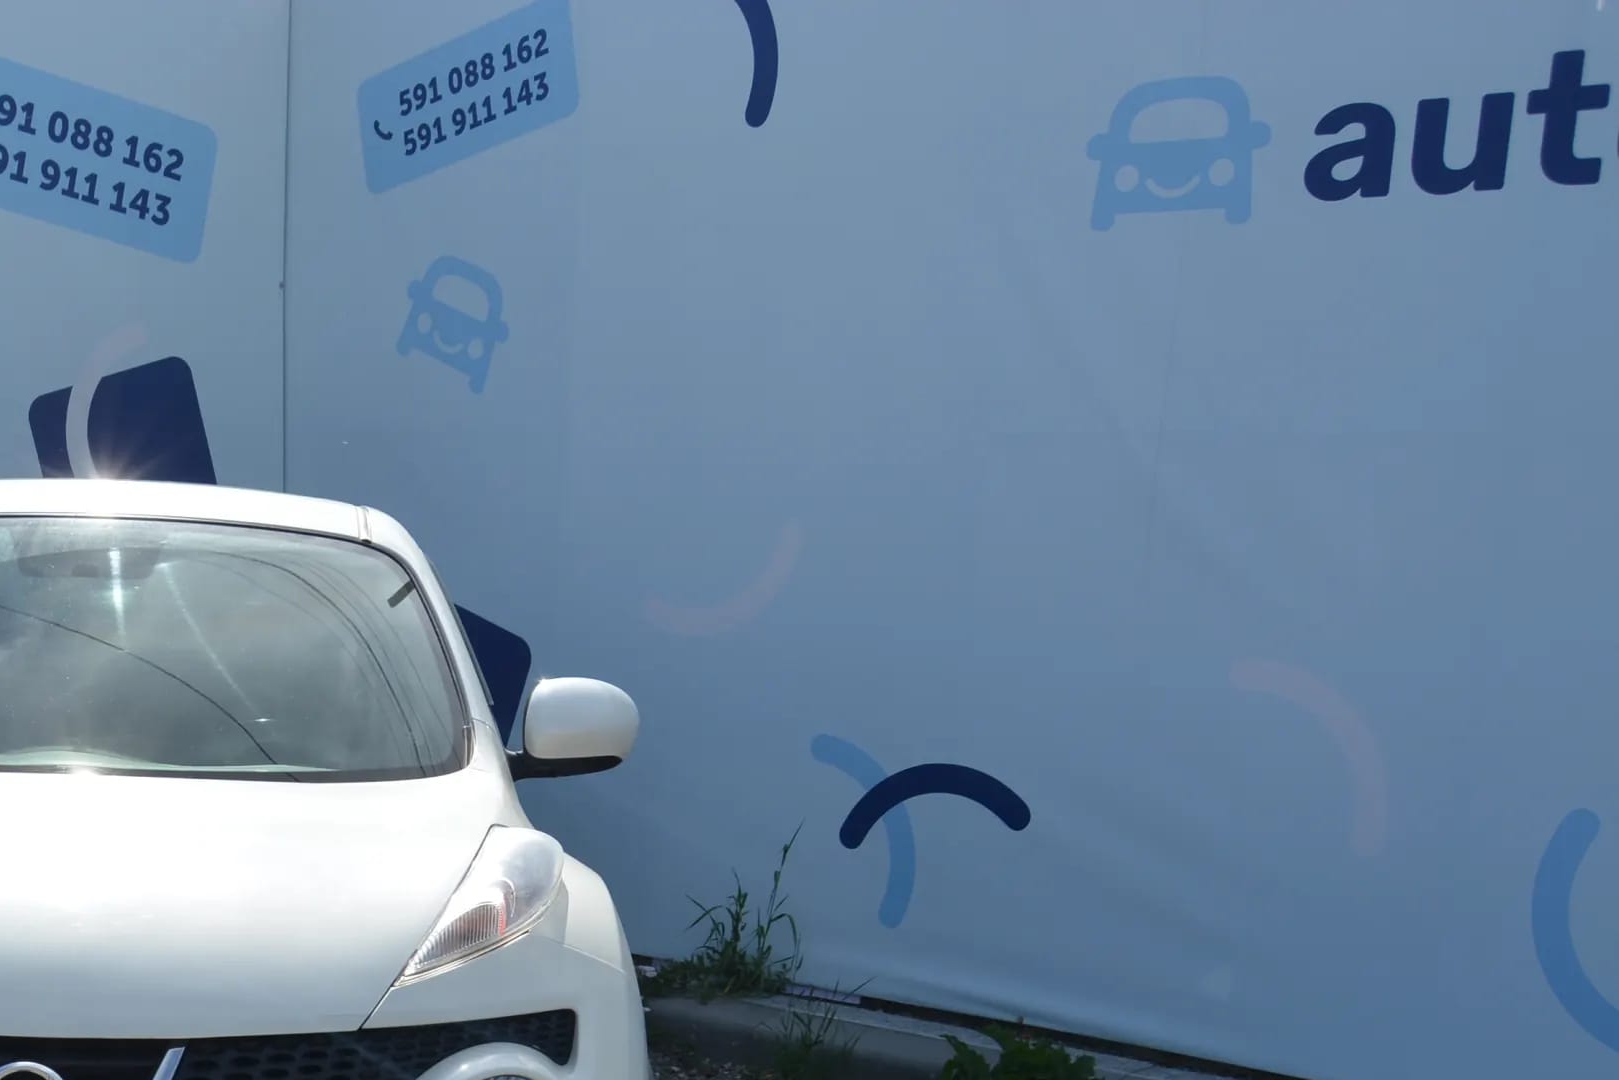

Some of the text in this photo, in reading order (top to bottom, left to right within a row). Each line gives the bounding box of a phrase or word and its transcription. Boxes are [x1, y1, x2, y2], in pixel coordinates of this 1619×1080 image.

[399, 28, 549, 116] 591 088 162
[403, 71, 549, 156] 591 911 143
[47, 111, 114, 158] 088
[122, 135, 184, 181] 162
[1303, 49, 1619, 202] aut
[39, 159, 100, 206] 911
[109, 181, 172, 226] 143
